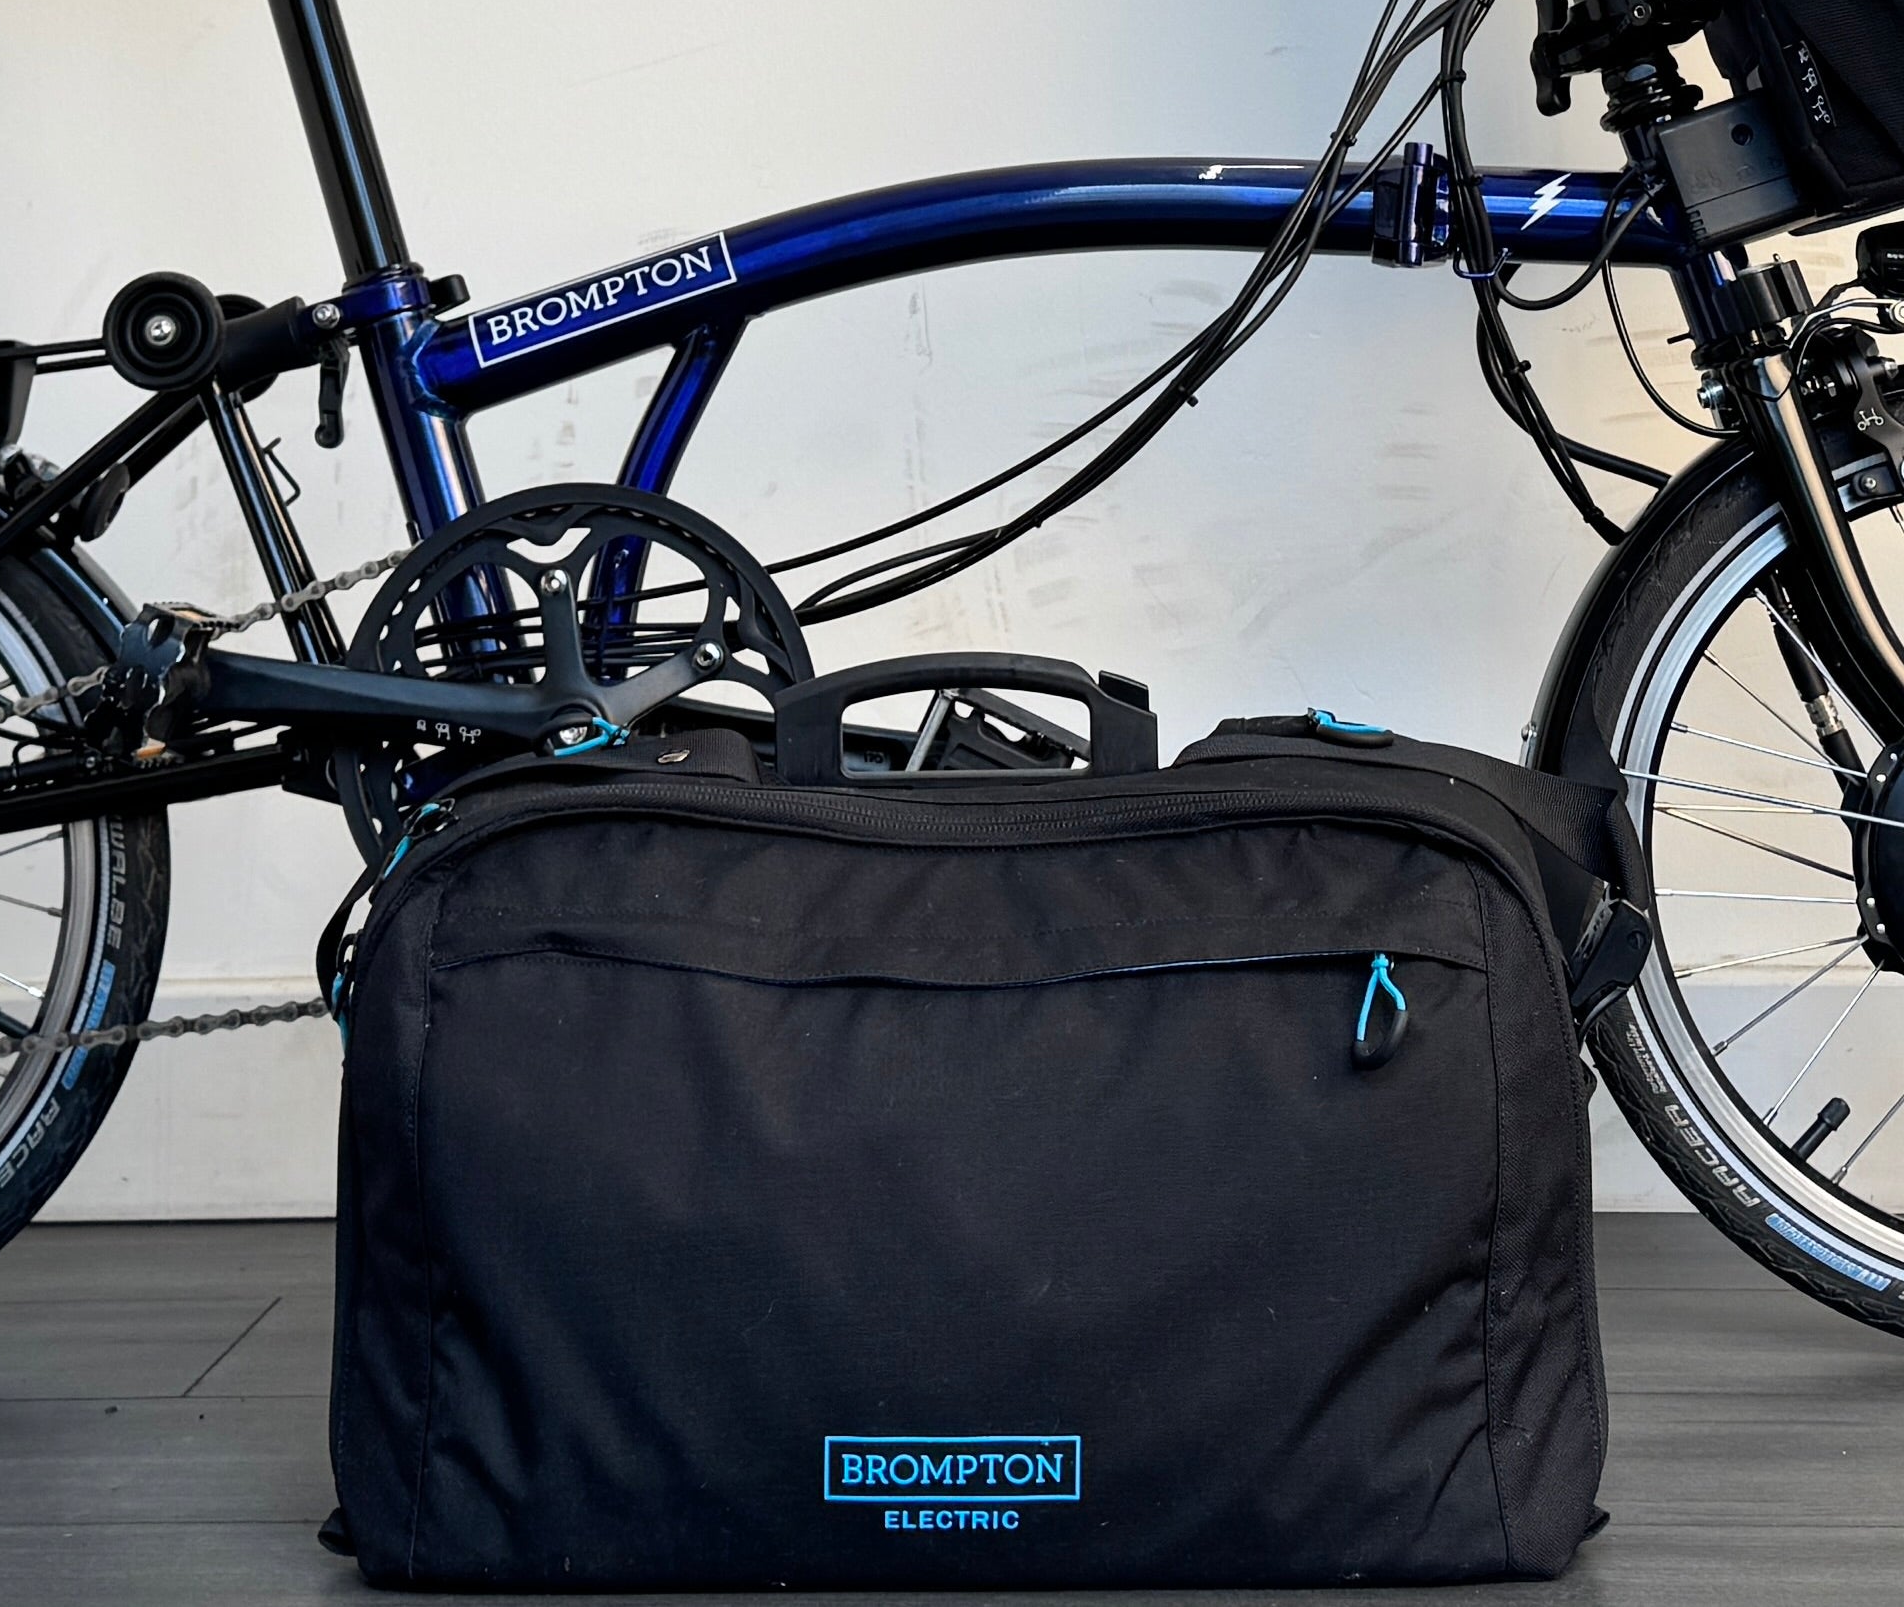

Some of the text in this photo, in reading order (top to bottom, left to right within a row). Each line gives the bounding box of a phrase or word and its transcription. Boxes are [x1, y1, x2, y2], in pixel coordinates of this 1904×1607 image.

[487, 246, 713, 345] BROMPTON
[1664, 1104, 1760, 1208] RACER
[841, 1453, 1064, 1485] BROMPTON
[884, 1510, 1019, 1530] ELECTRIC
